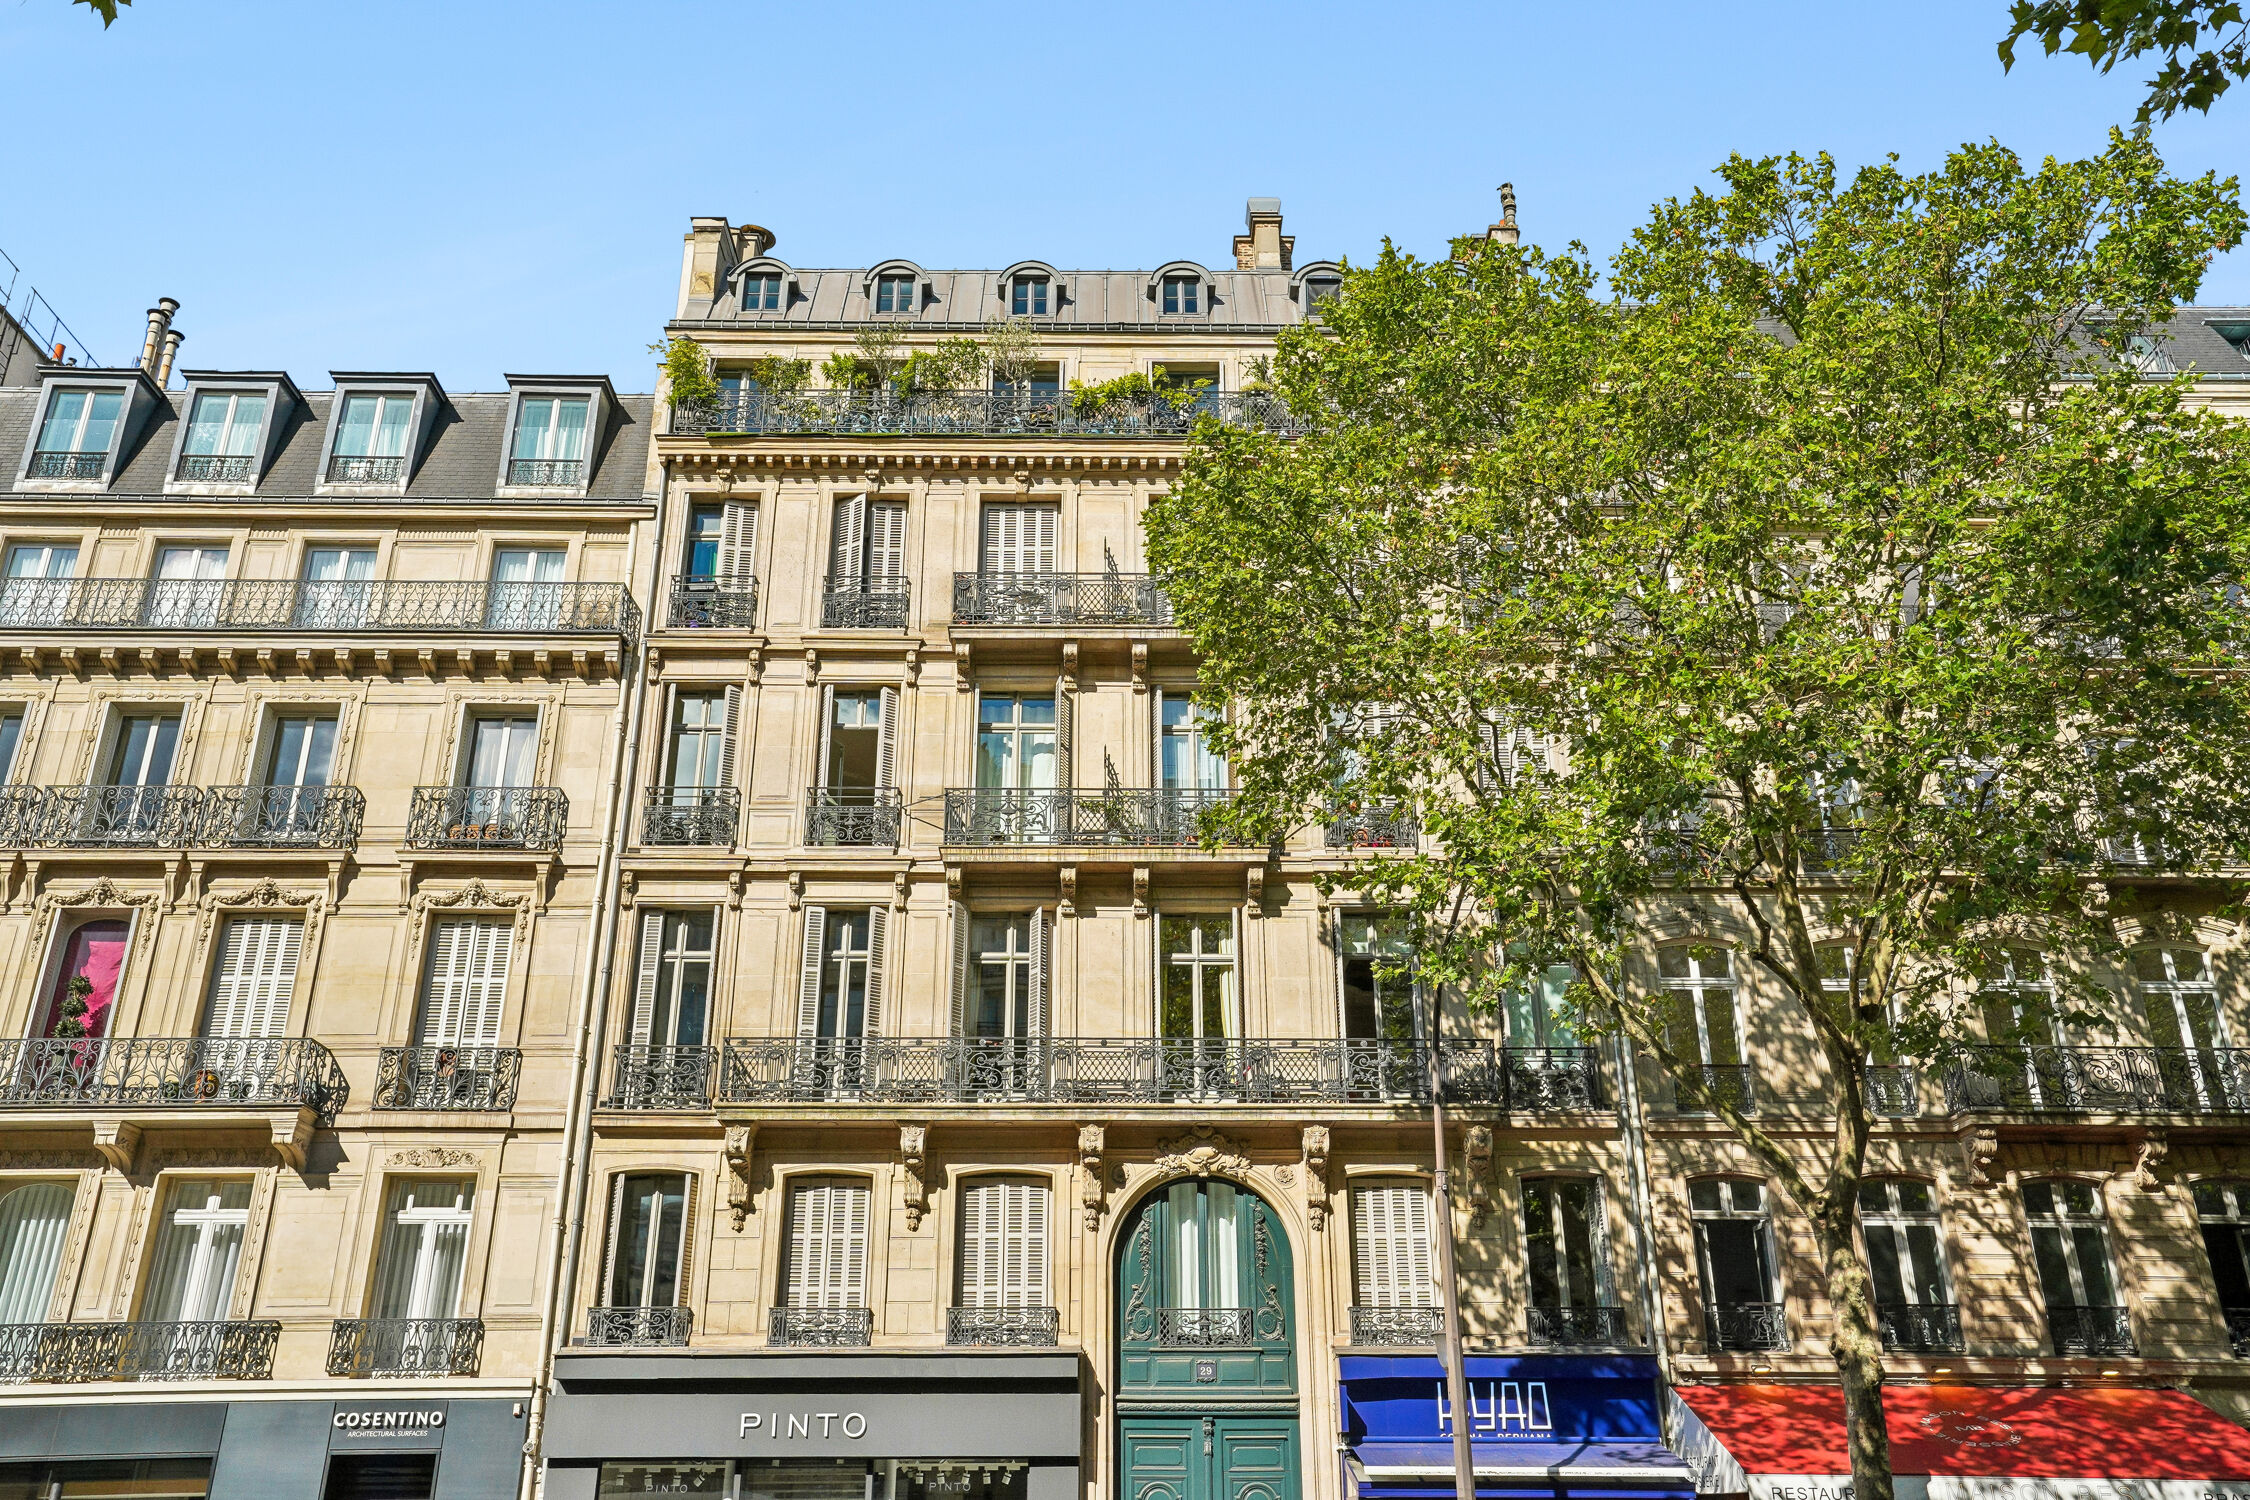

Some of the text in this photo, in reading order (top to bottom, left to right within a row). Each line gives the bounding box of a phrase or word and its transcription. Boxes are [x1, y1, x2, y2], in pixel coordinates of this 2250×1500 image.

[1200, 1366, 1212, 1376] 29
[333, 1411, 444, 1427] COSENTINO
[740, 1412, 867, 1438] PINTO
[347, 1430, 396, 1438] ARCHITECTURAL
[1683, 1455, 1719, 1469] ESTAURANT
[645, 1484, 688, 1493] PINTO
[928, 1482, 971, 1492] PINTO
